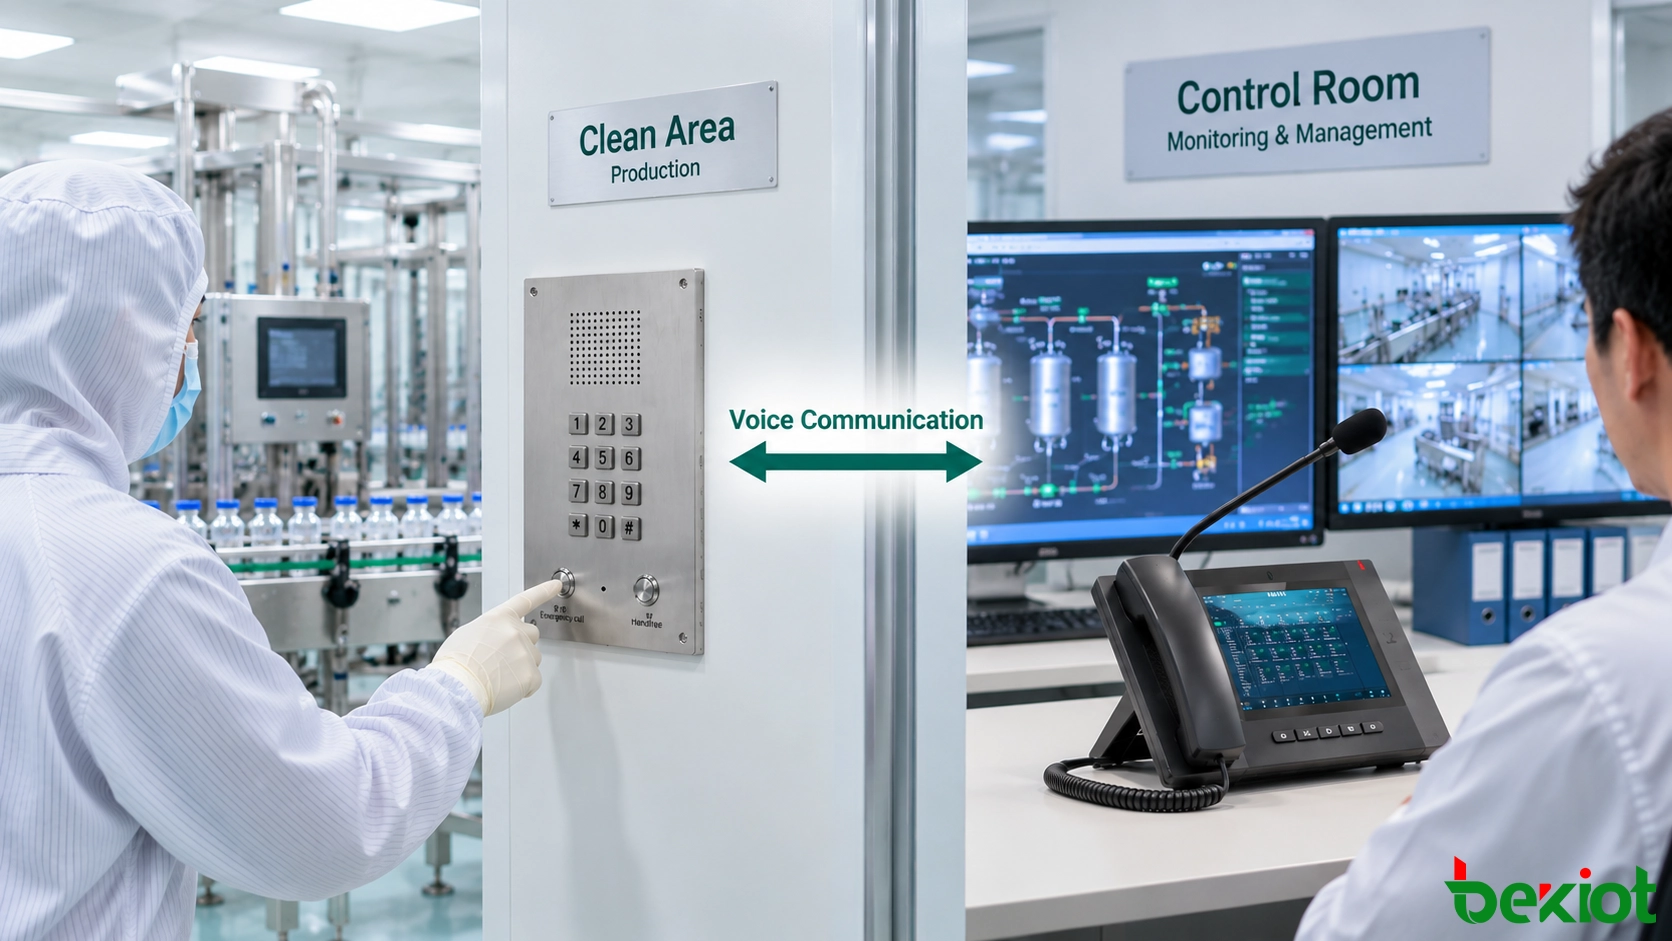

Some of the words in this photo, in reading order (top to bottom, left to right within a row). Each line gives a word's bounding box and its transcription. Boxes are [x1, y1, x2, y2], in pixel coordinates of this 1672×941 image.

[1177, 71, 1301, 115] Control
[1313, 69, 1420, 106] Room
[579, 122, 656, 157] Clean
[665, 114, 735, 148] Area
[1167, 126, 1269, 152] Monitoring
[1275, 124, 1290, 146] &
[1296, 116, 1433, 146] Management
[611, 159, 701, 184] Production
[573, 416, 580, 431] 1
[598, 416, 607, 431] 2
[625, 417, 633, 431] 3
[572, 450, 581, 464] 4
[598, 450, 607, 465] 5
[625, 451, 633, 466] 6
[572, 484, 581, 498] 7
[598, 485, 607, 500] 8
[624, 486, 633, 501] 9
[598, 519, 607, 533] 0
[624, 521, 634, 535] #
